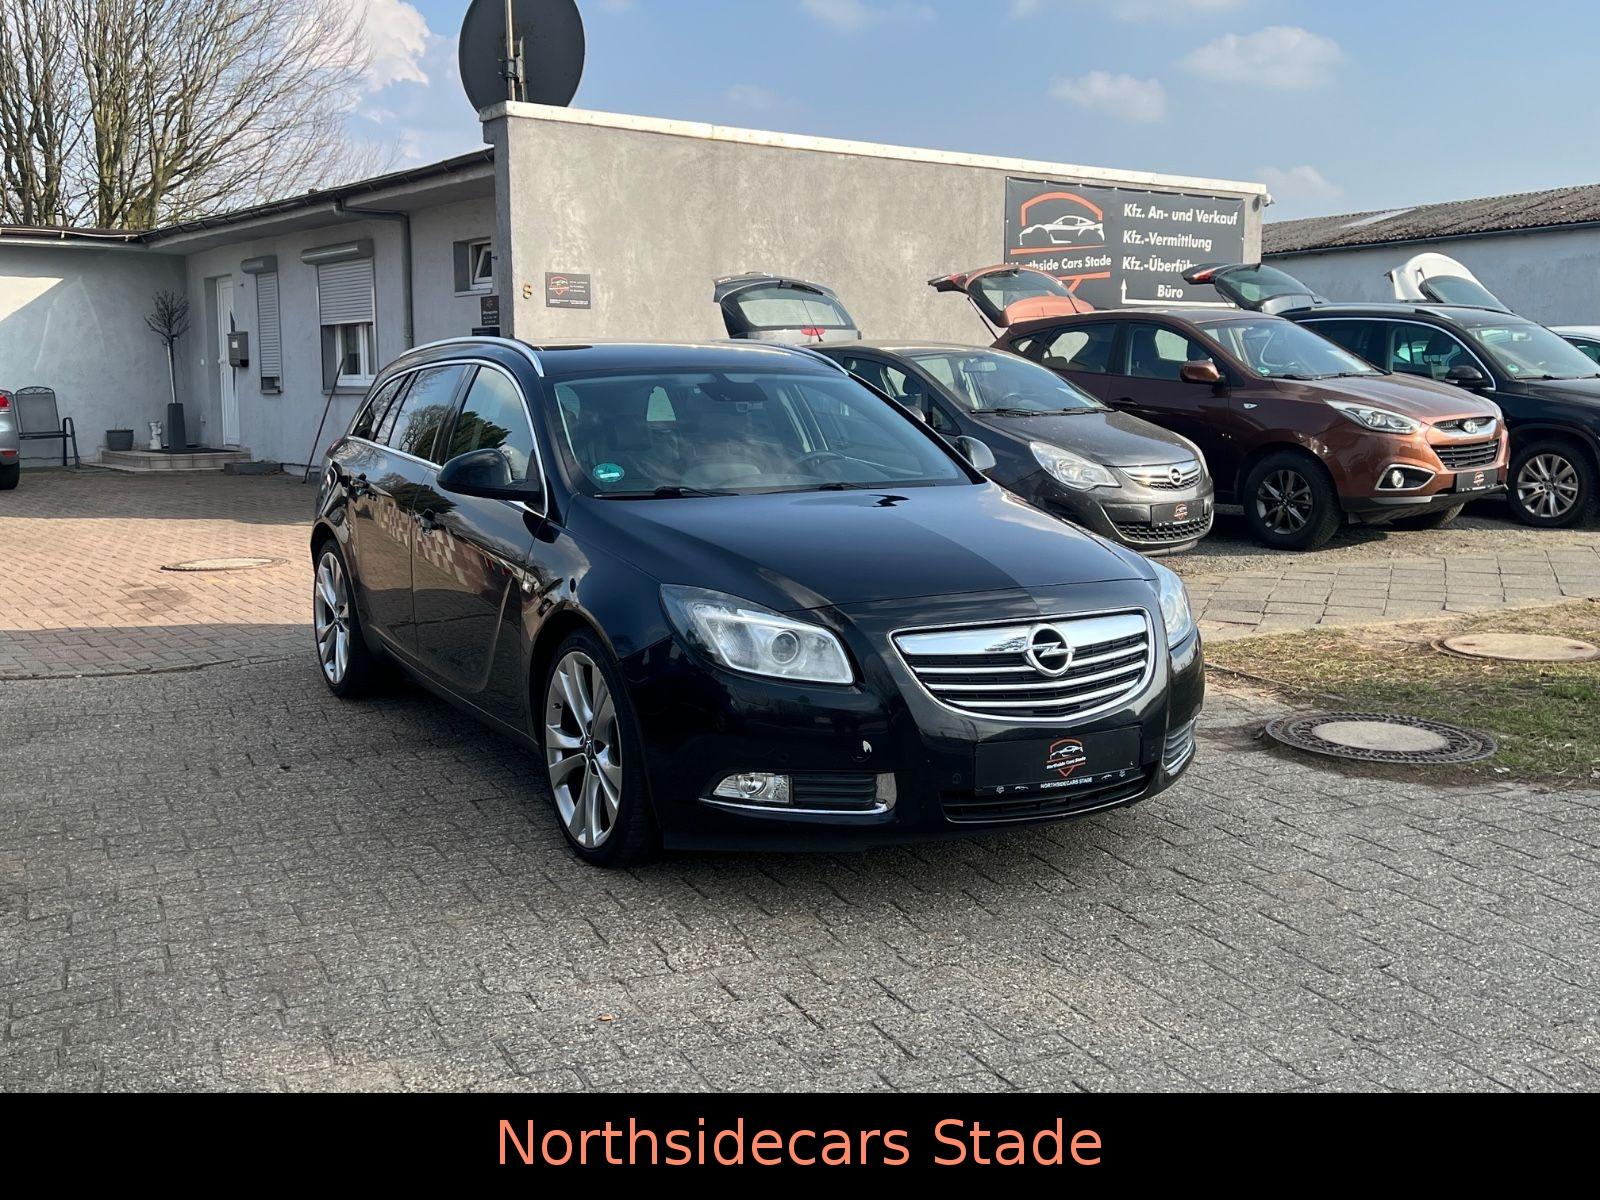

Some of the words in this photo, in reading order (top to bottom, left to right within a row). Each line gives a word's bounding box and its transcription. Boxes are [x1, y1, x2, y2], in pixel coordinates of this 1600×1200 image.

[1123, 203, 1145, 218] Kfz.
[1148, 206, 1168, 219] An-
[1172, 208, 1193, 221] und
[1196, 209, 1238, 225] Verkauf
[1123, 230, 1212, 252] Kfz.-Vermittlung
[1061, 258, 1083, 269] Cars
[1084, 254, 1112, 267] Stade
[1157, 284, 1183, 298] Büro
